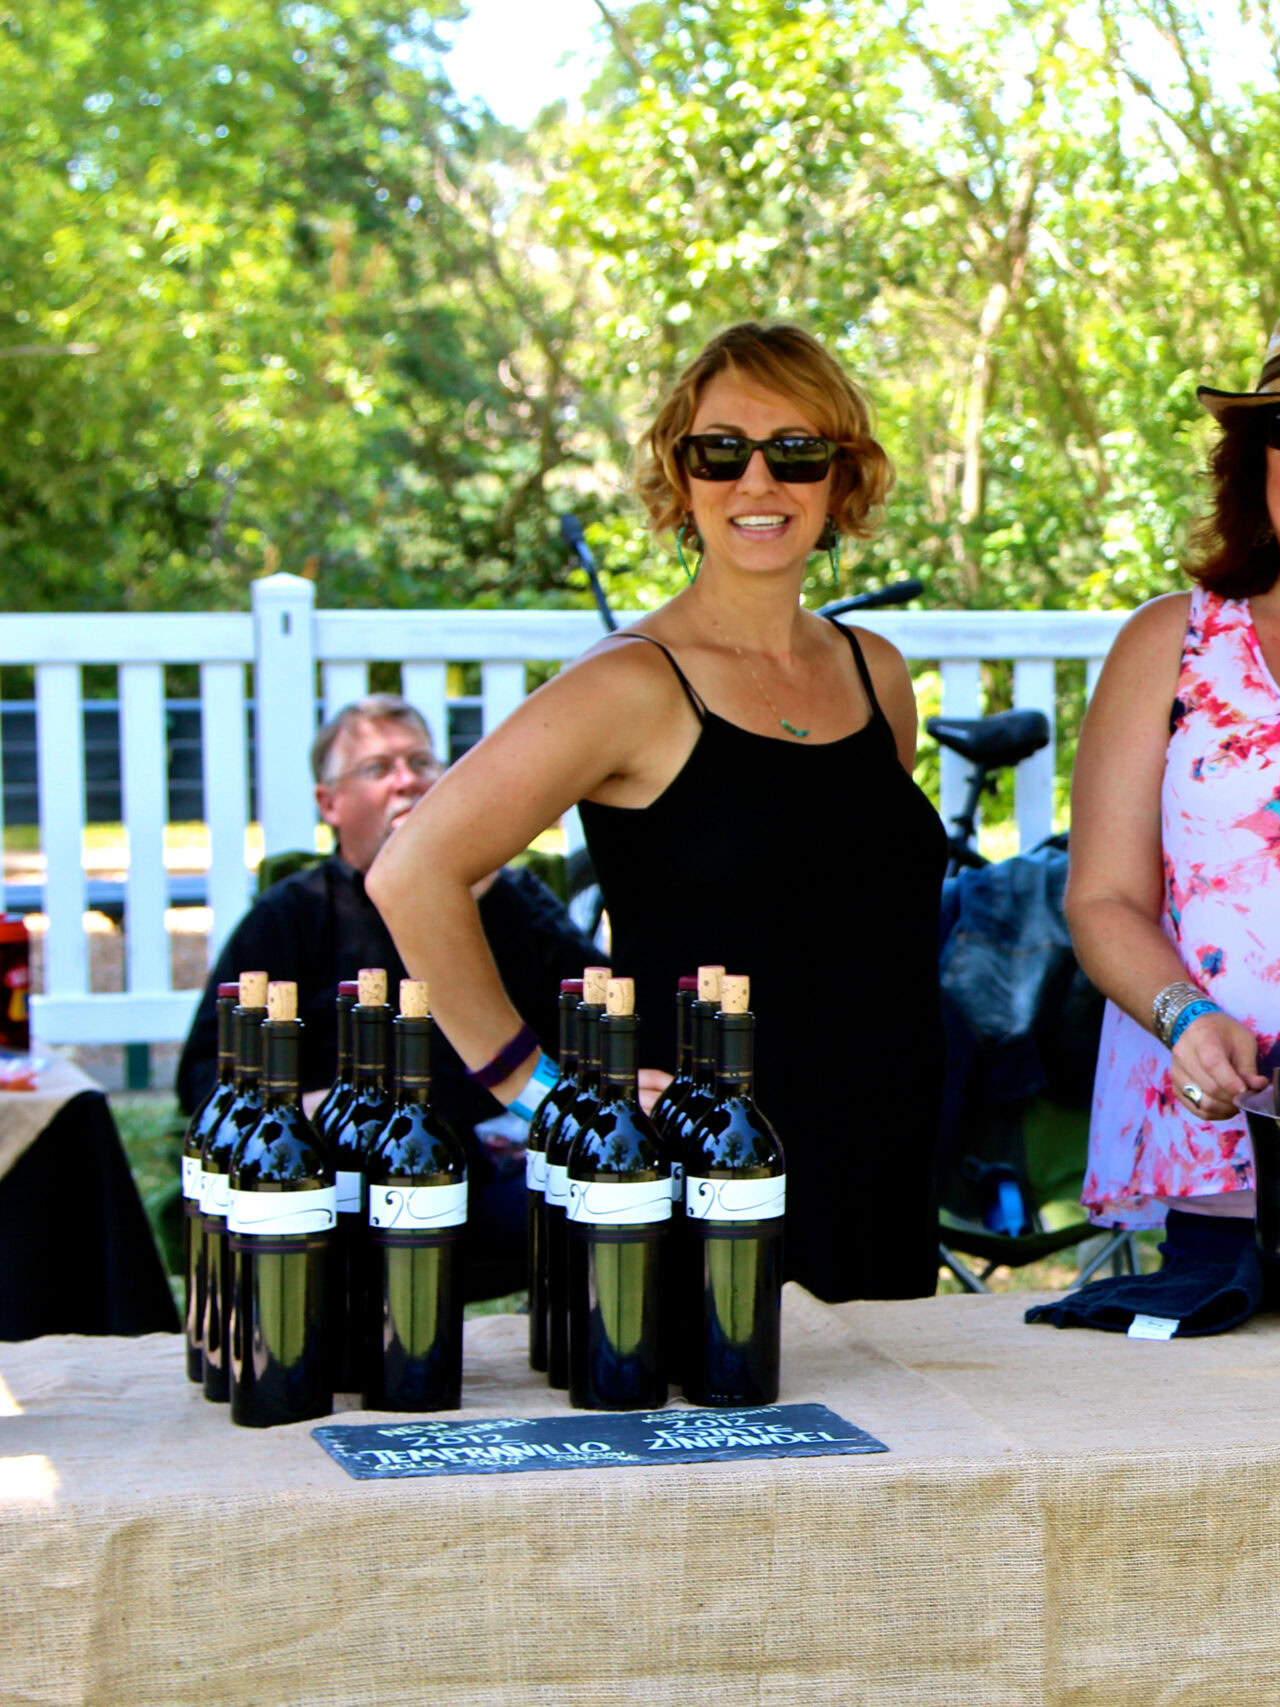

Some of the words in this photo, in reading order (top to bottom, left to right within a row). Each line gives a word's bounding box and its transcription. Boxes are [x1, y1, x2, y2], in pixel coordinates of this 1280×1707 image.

[663, 1417, 765, 1429] 2012
[653, 1424, 794, 1440] ESTATE
[401, 1433, 522, 1447] 2012
[643, 1431, 857, 1450] ZINFANDEL
